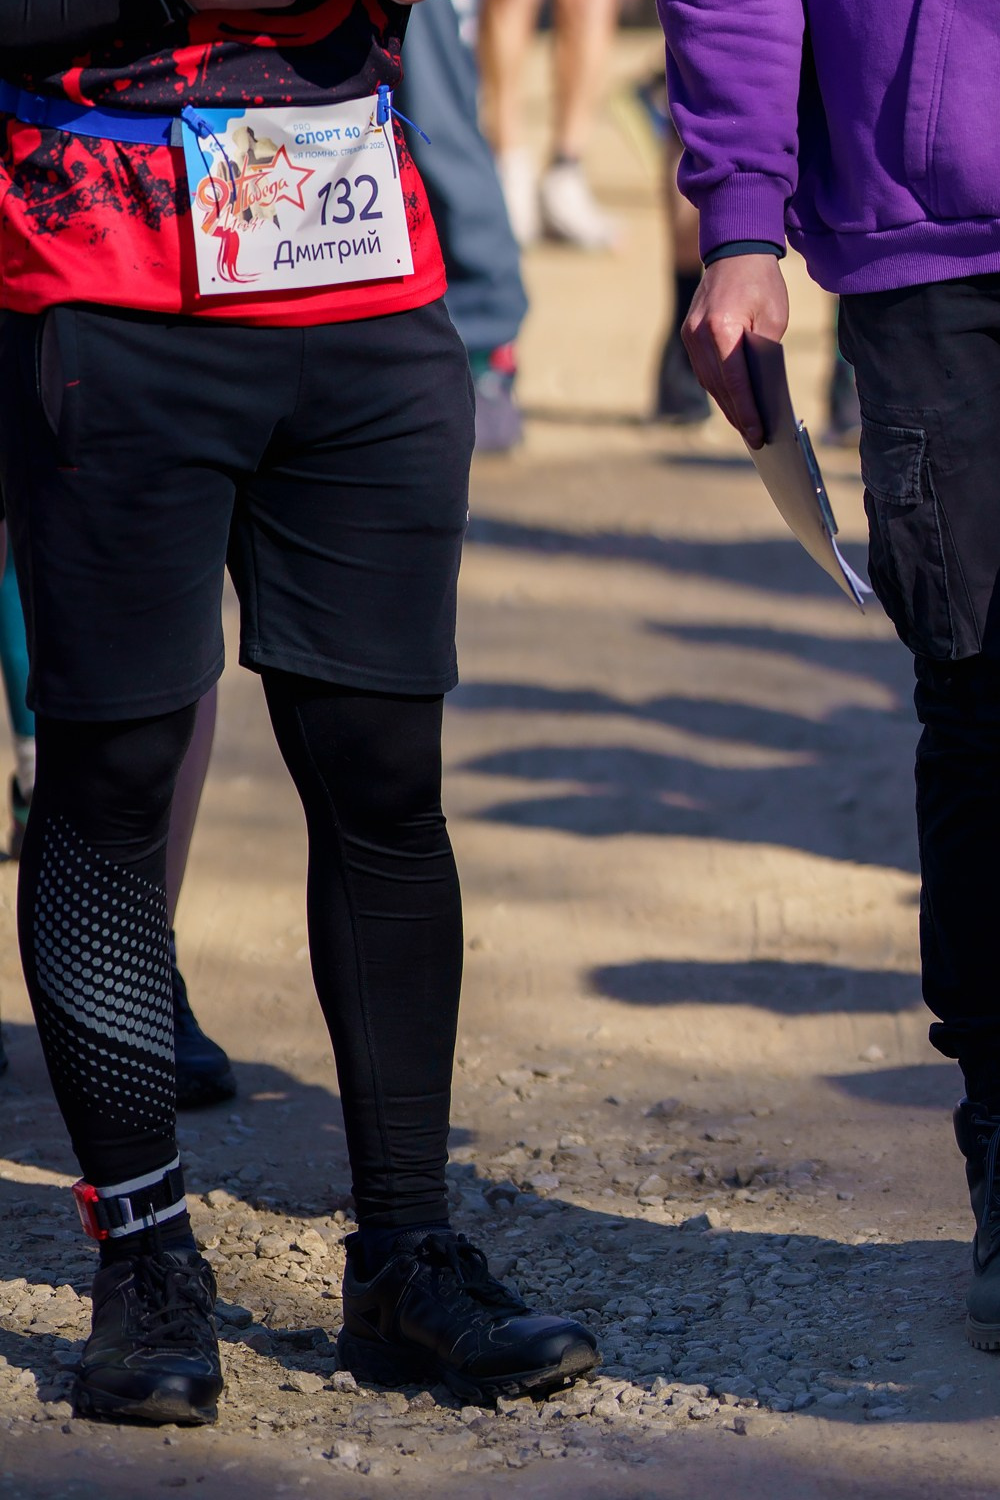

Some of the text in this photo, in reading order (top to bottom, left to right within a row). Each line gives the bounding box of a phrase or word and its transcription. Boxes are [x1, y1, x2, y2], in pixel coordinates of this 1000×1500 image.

[293, 123, 311, 131] PRO
[294, 126, 361, 145] СПОРТ 40
[369, 142, 385, 150] 2025
[198, 176, 230, 234] 9
[317, 174, 383, 226] 132
[273, 229, 382, 270] Дмитрий
